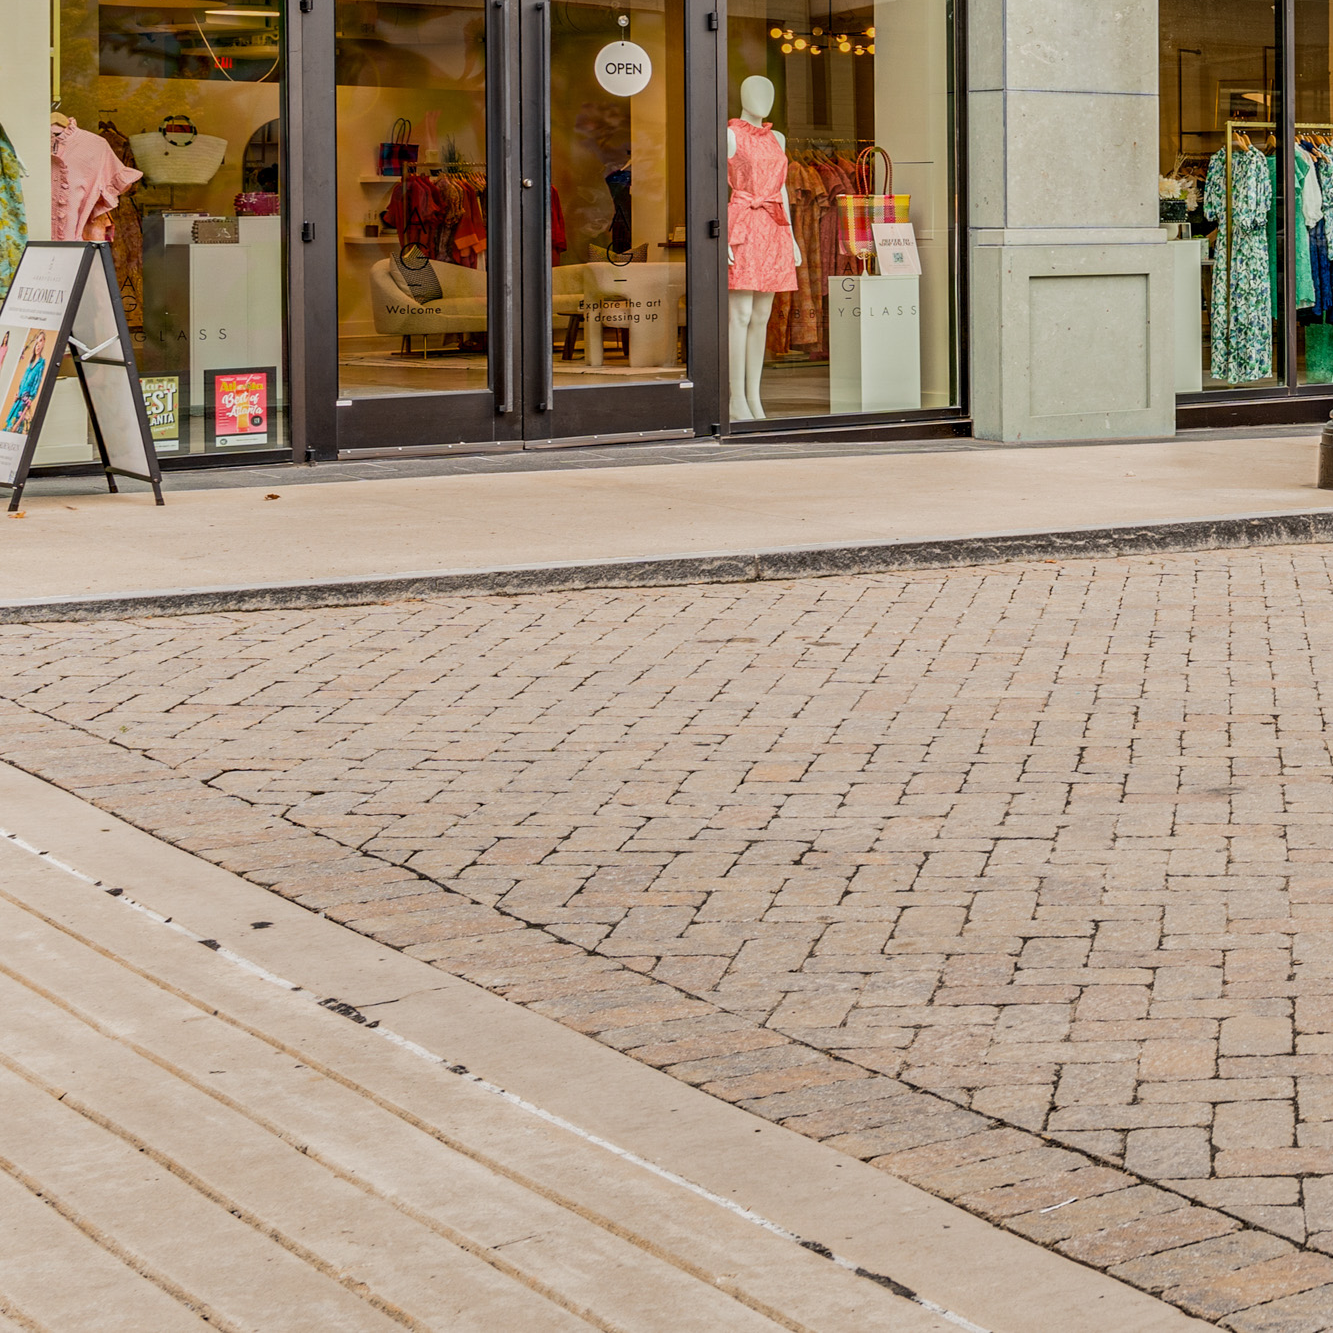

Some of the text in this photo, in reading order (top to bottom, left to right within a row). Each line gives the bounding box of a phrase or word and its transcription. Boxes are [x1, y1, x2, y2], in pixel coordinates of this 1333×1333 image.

[605, 62, 642, 75] OPEN
[17, 286, 56, 304] WELCOME
[386, 304, 442, 315] Welcome
[579, 298, 661, 312] Explore the art
[594, 312, 640, 323] dressing
[645, 313, 658, 323] up
[778, 305, 918, 320] ABBYGLASS
[133, 328, 228, 343] GLASS
[143, 388, 177, 415] EST
[222, 392, 248, 408] Best
[149, 413, 175, 426] ANTA
